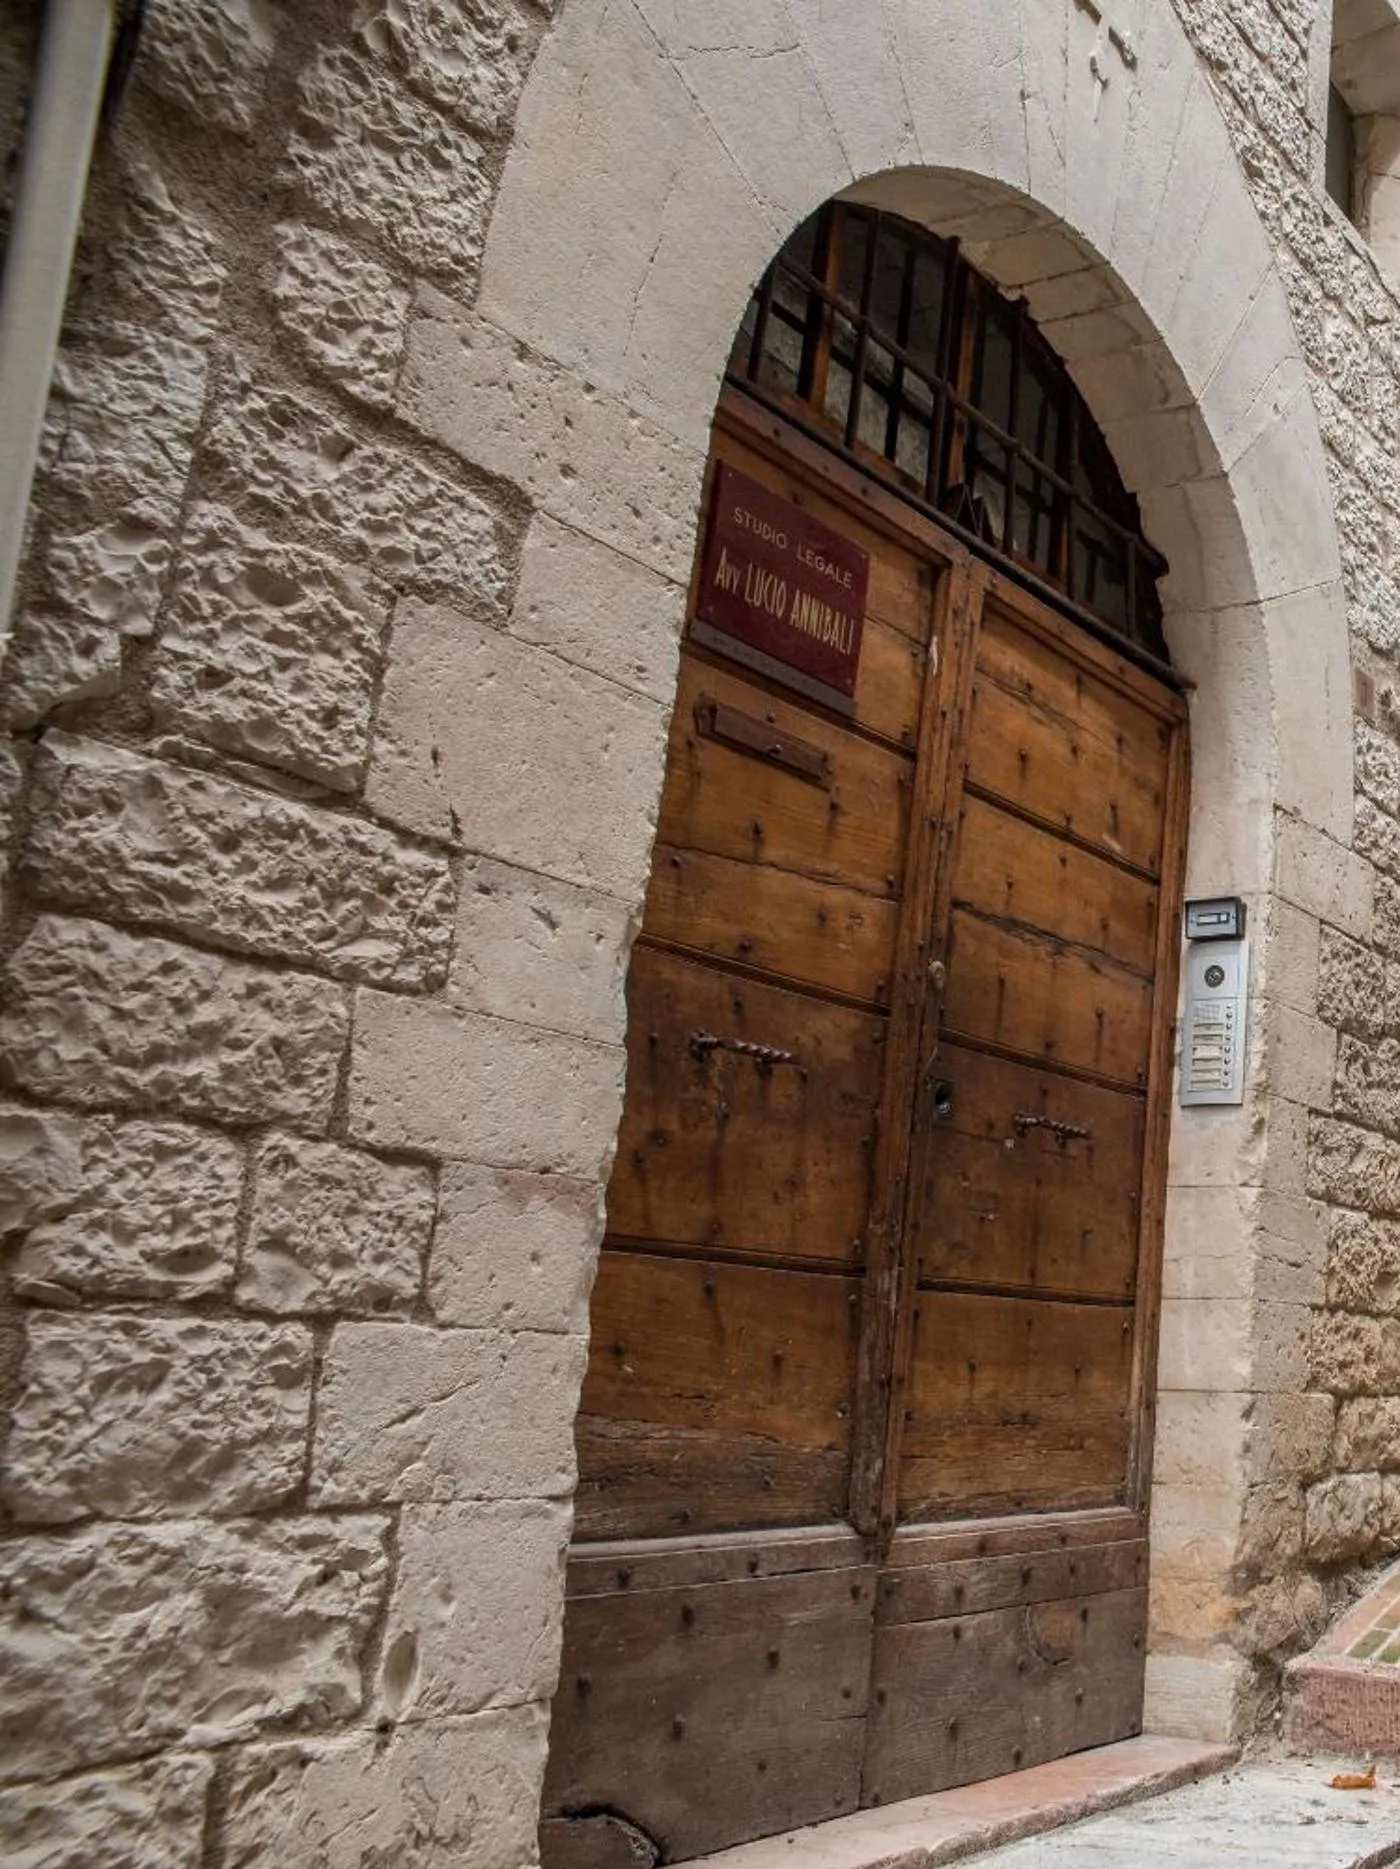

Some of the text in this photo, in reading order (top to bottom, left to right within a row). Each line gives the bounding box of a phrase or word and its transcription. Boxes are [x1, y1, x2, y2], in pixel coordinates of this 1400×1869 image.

[733, 507, 853, 590] STUDIO LEGALE
[744, 562, 787, 620] LUCIO
